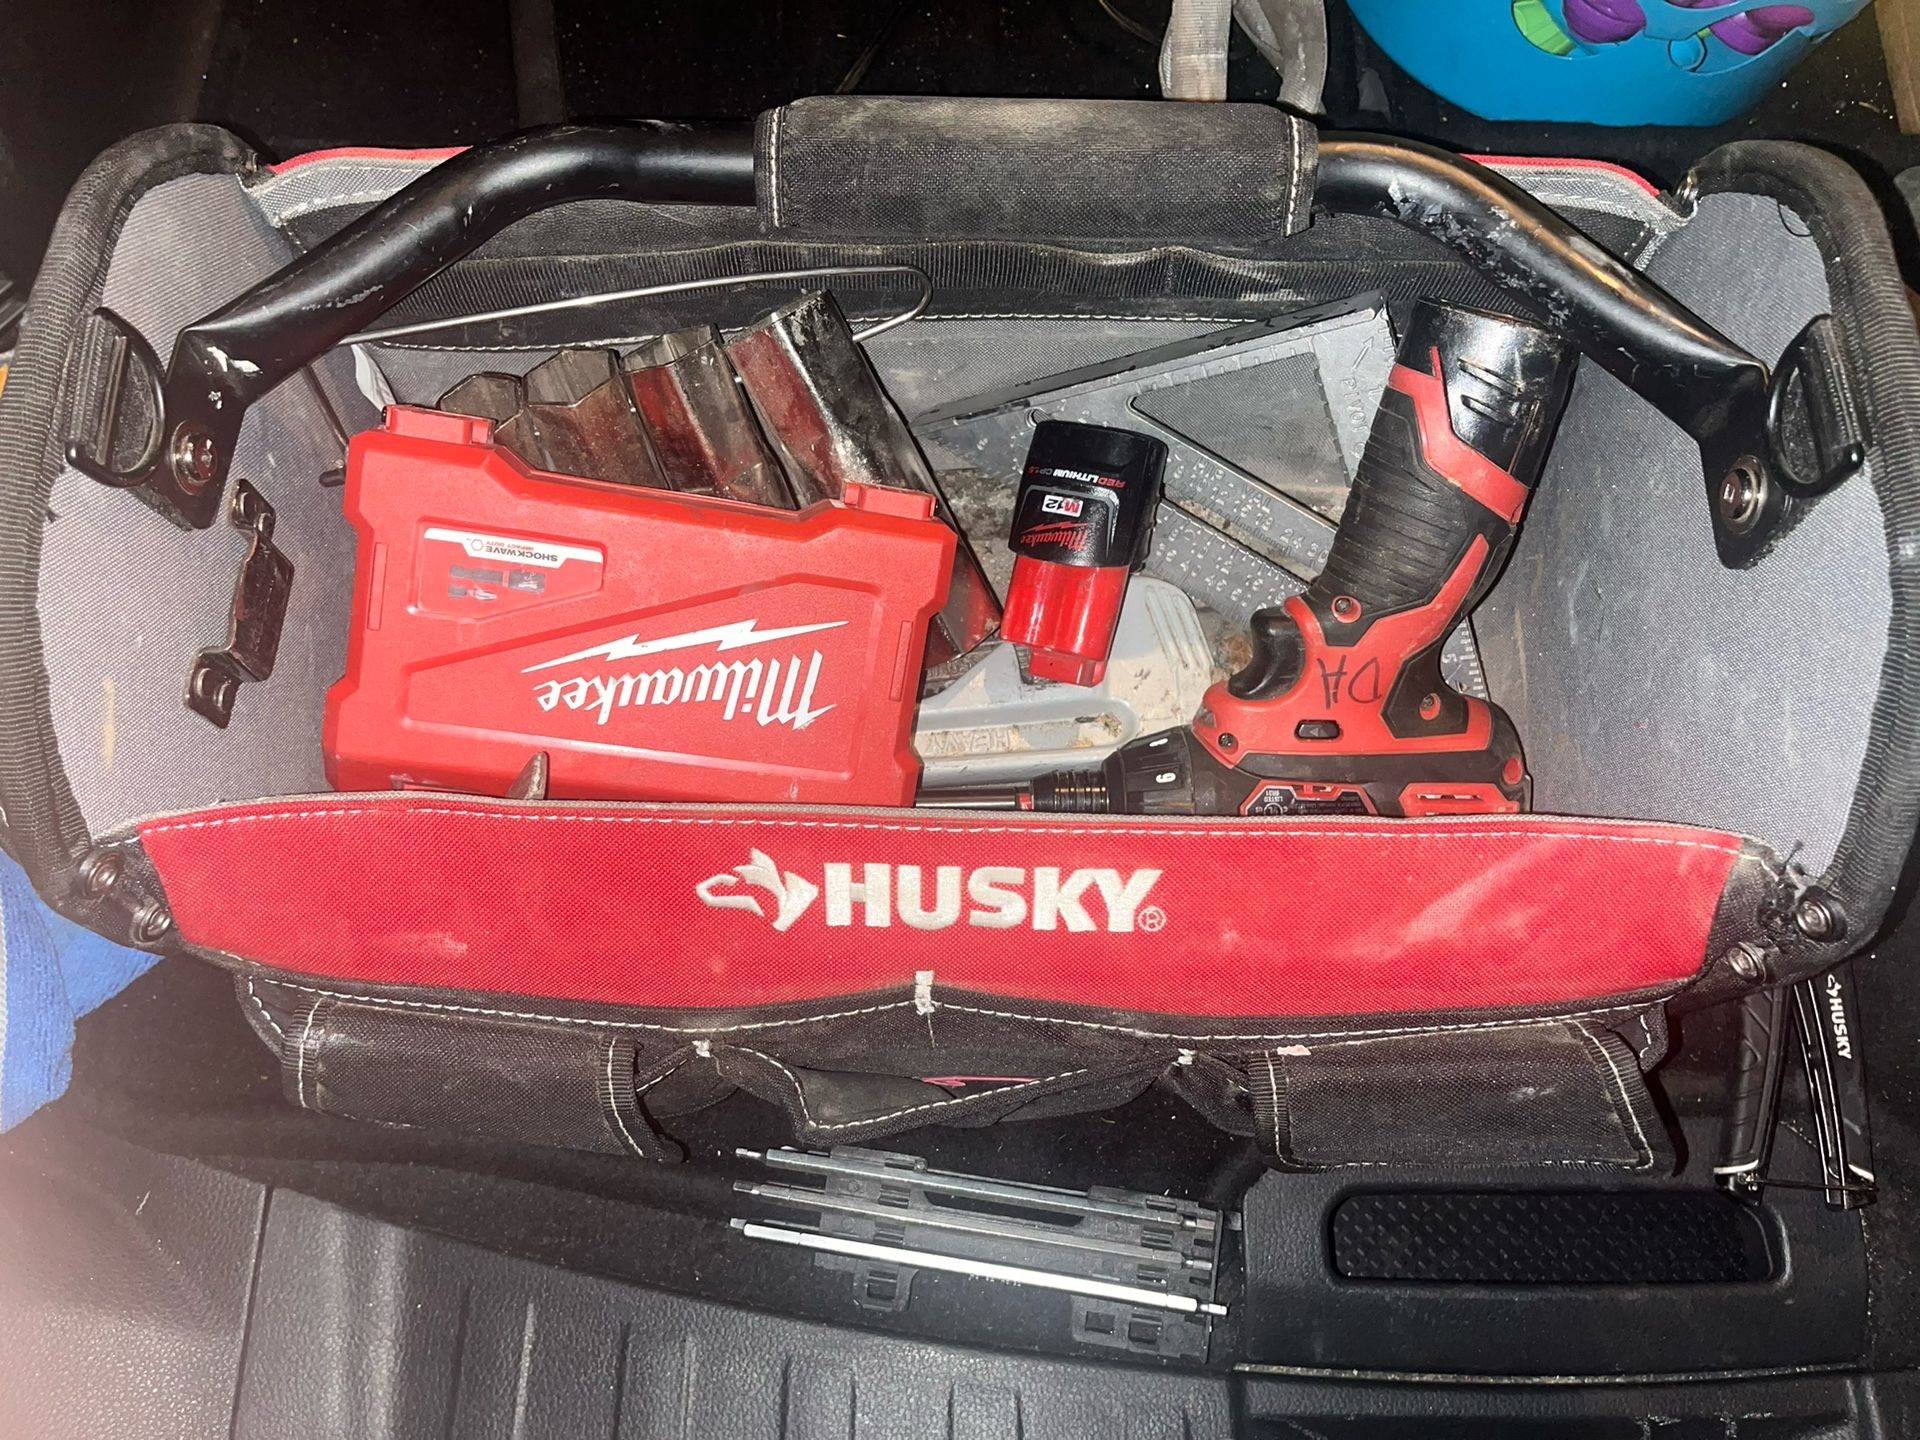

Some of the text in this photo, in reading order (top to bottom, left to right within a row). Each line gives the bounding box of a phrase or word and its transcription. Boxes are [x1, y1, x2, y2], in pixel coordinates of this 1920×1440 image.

[485, 546, 558, 562] SHOCKWAVE
[1020, 530, 1088, 551] Milwaukee
[532, 650, 838, 730] Milwaukee
[1829, 998, 1852, 1060] HUSKY
